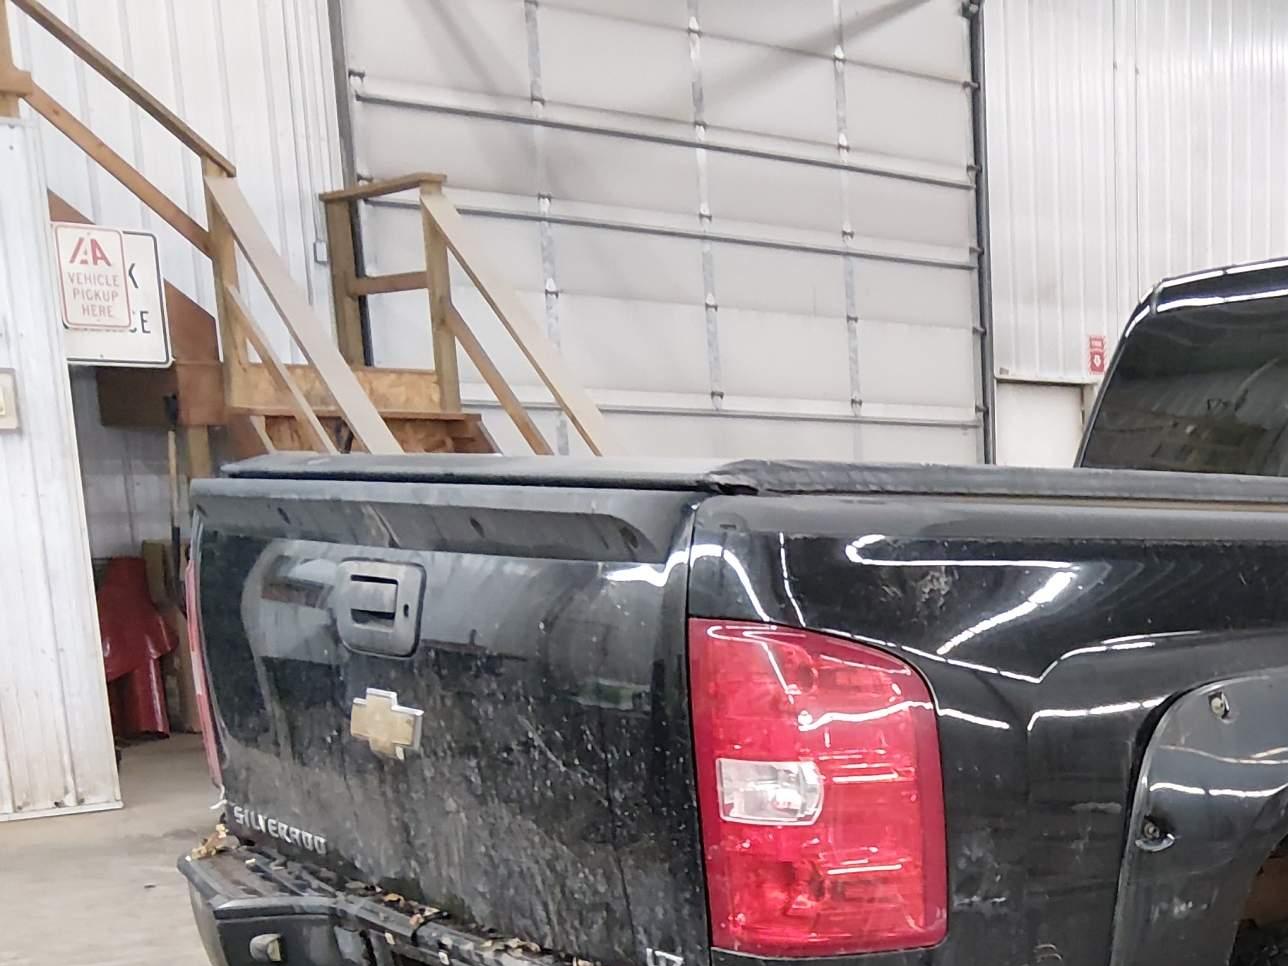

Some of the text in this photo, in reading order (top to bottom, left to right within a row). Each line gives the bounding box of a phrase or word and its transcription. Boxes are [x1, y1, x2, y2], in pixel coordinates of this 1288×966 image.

[67, 271, 120, 288] VEHICLE
[72, 287, 119, 303] PICKUP
[81, 303, 114, 318] HERE
[233, 805, 327, 855] SILVERADO
